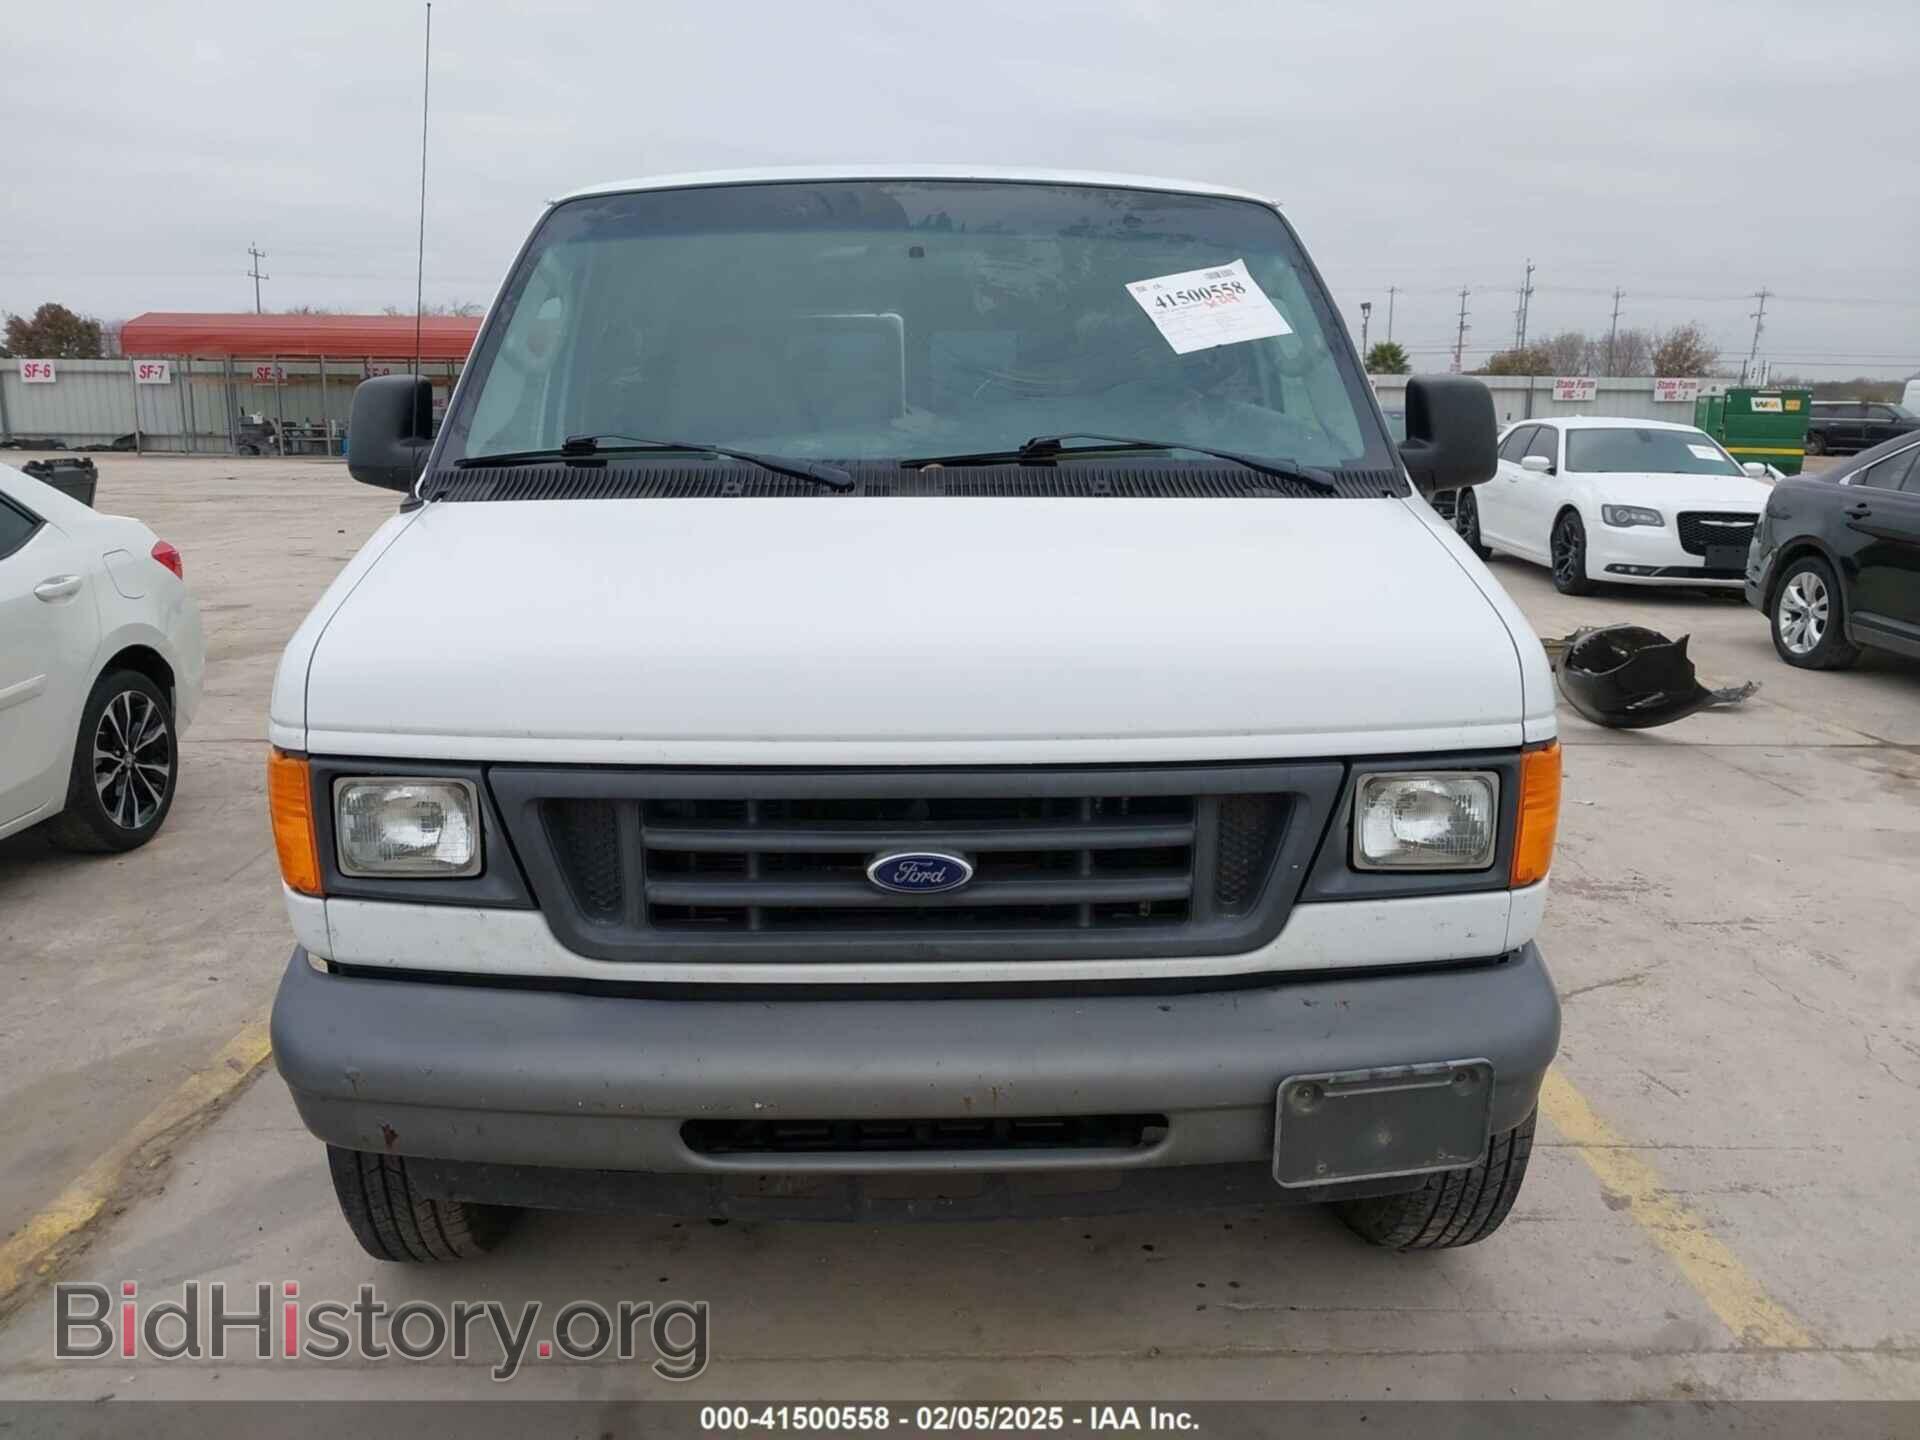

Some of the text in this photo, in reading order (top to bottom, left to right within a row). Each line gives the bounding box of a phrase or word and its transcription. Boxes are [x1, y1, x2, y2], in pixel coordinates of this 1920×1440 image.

[1155, 281, 1246, 309] 41500558
[24, 363, 51, 378] SF-6
[139, 364, 165, 379] SF-7
[1556, 380, 1595, 389] State Farm
[1657, 380, 1696, 389] State Farm
[894, 861, 947, 883] Ford
